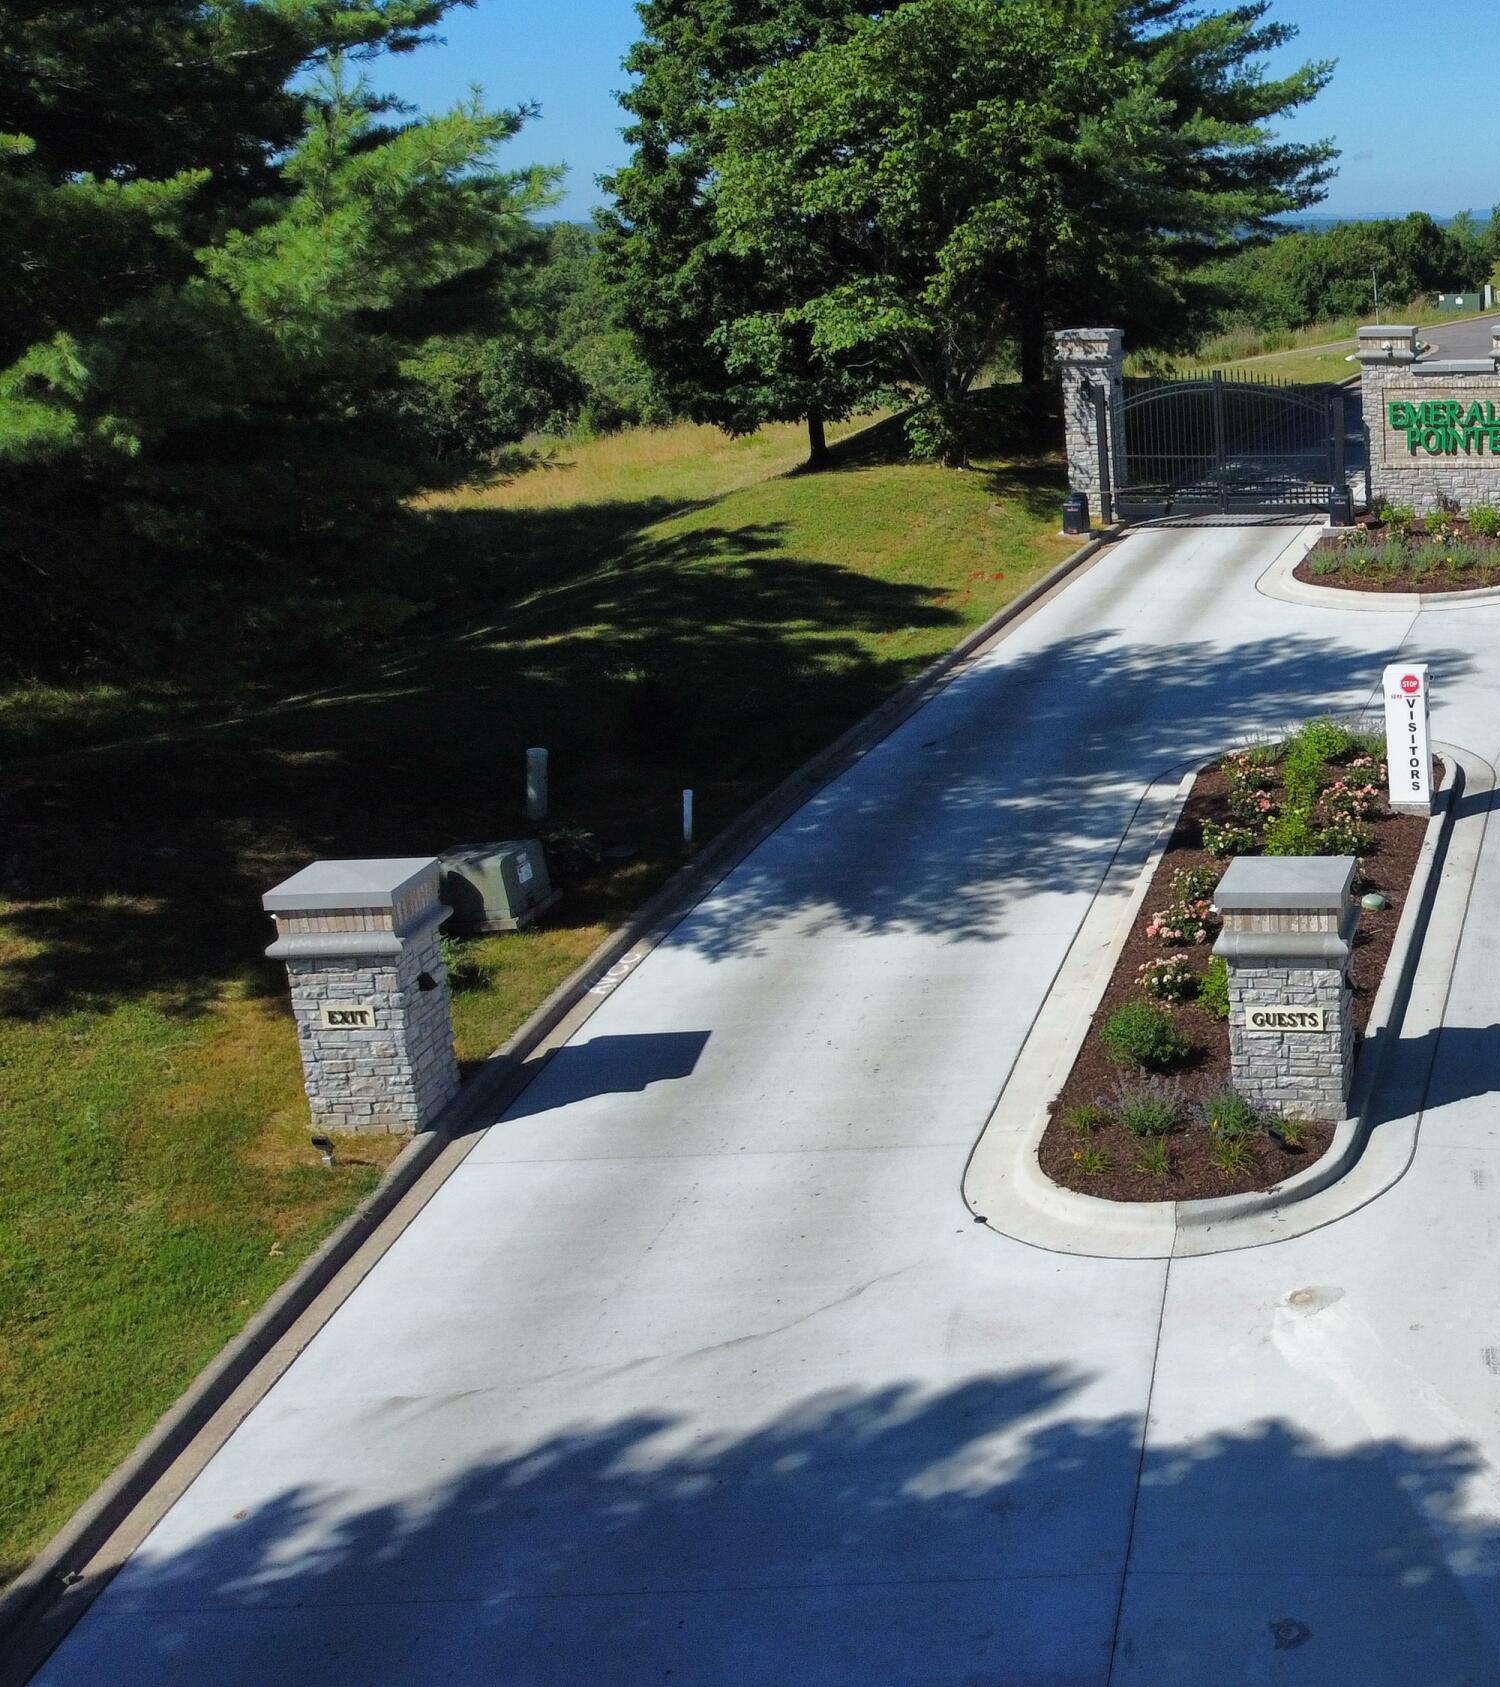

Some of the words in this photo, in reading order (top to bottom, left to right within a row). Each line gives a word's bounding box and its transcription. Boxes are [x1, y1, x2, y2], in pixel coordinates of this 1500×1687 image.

[1402, 680, 1418, 688] STOP
[1406, 698, 1421, 791] VISITORS
[327, 1010, 370, 1026] EXIT
[1252, 1012, 1319, 1028] GUESTS
